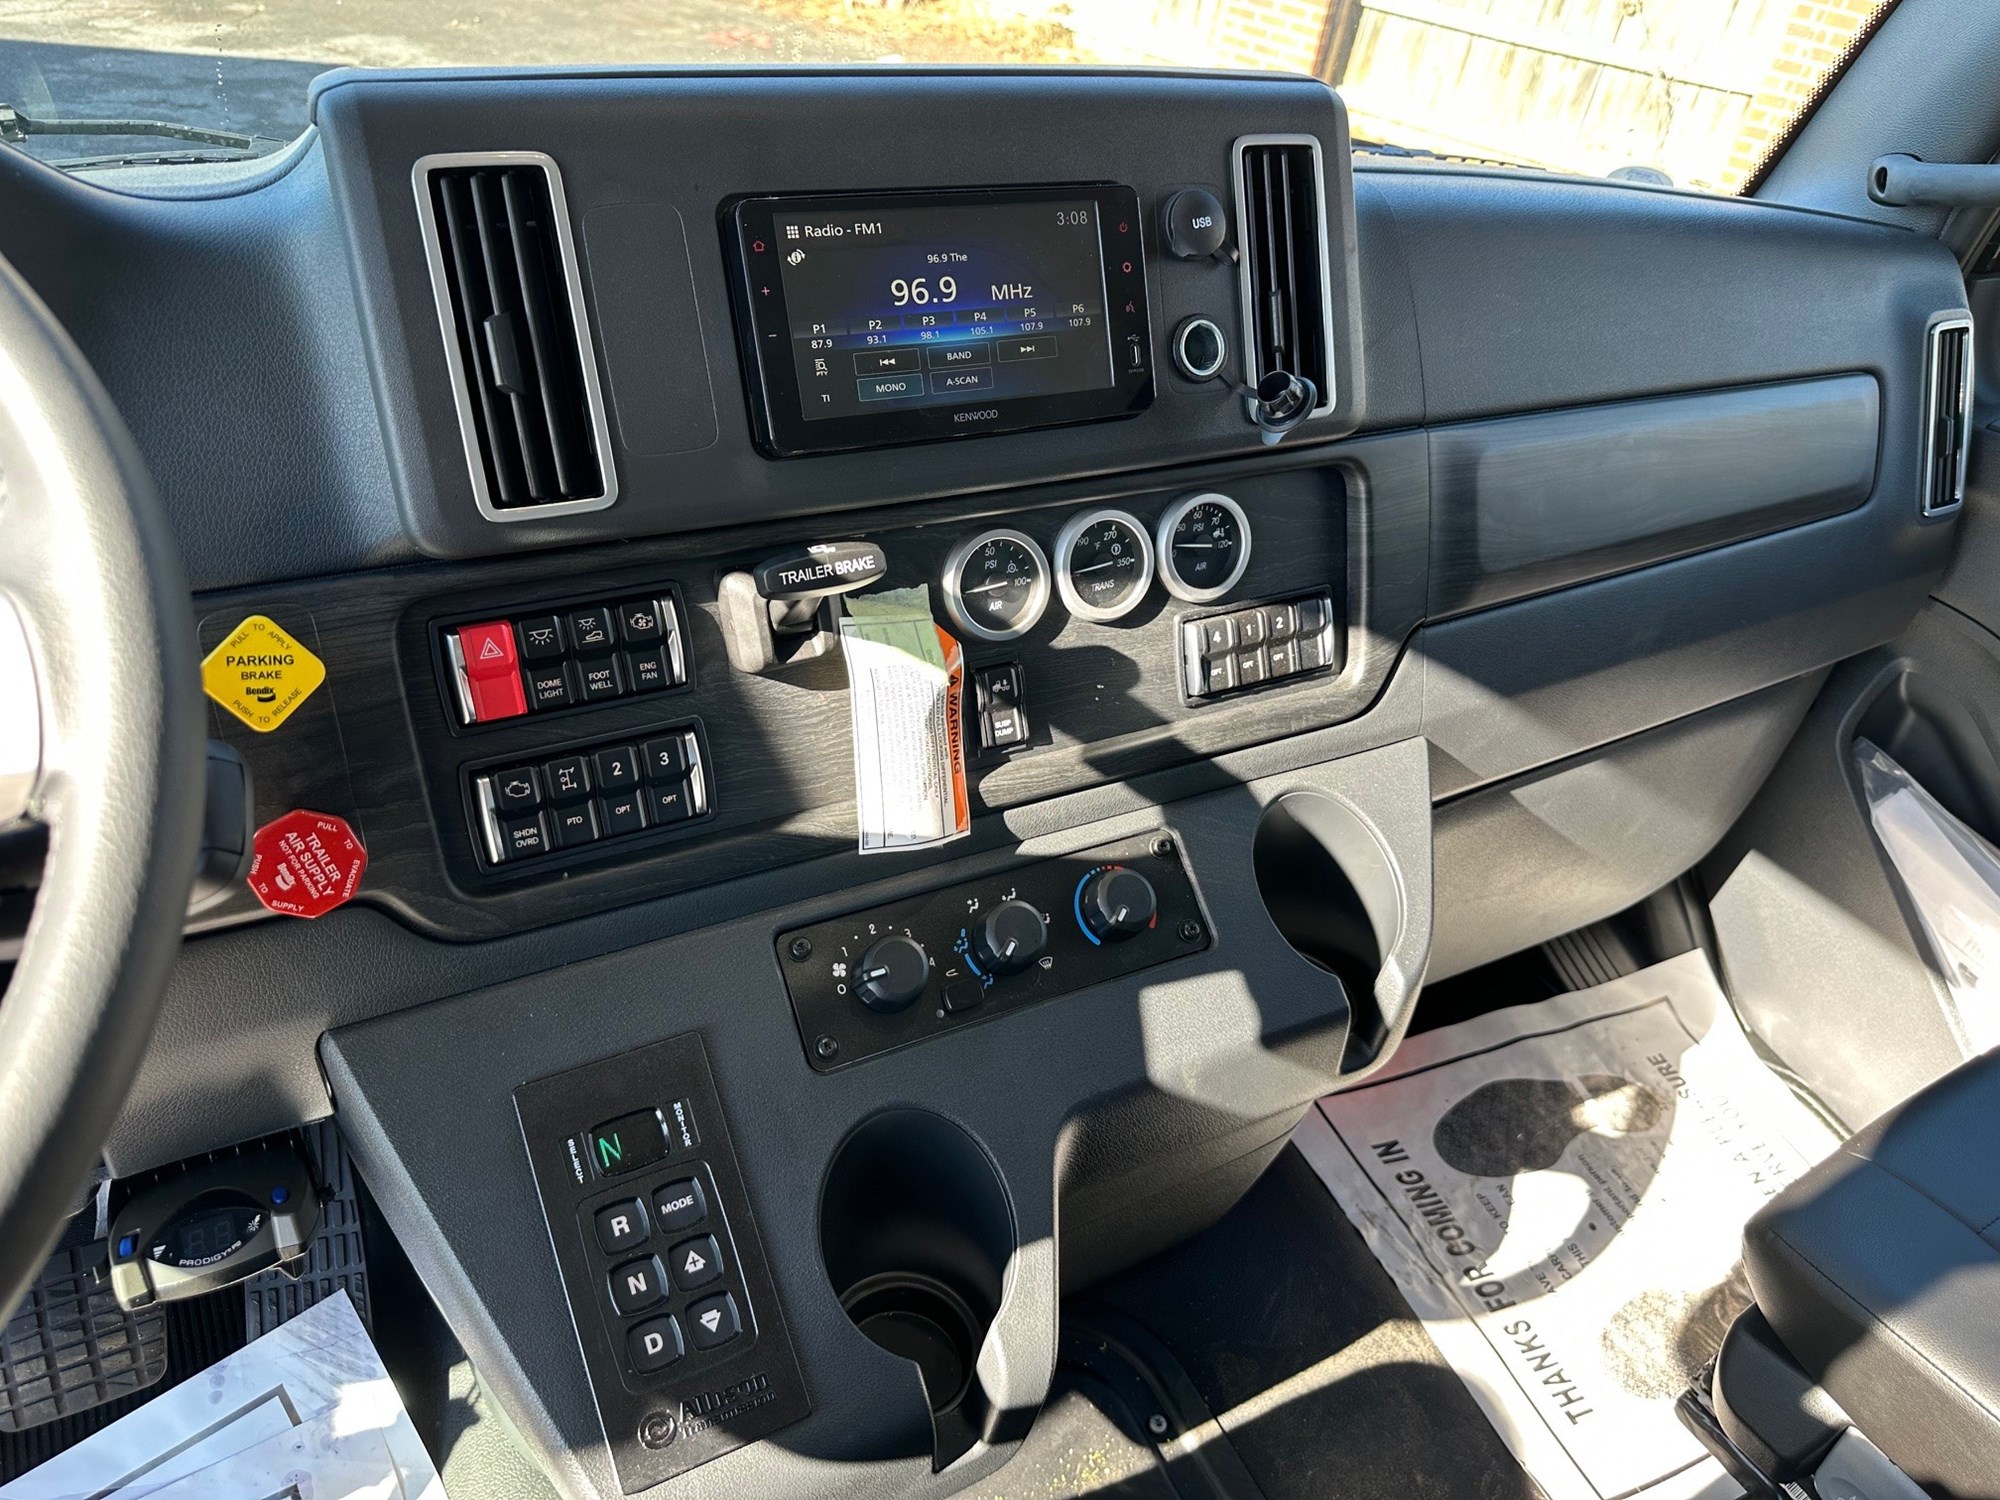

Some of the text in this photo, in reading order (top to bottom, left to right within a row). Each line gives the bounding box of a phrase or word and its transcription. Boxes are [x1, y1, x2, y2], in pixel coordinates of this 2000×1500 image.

[1056, 211, 1088, 226] 3:08
[1192, 216, 1213, 229] USB
[804, 223, 844, 238] Radio
[854, 222, 883, 235] FM1
[926, 253, 968, 264] 96.9 The
[890, 275, 1033, 307] 96.9 MHz
[812, 303, 1085, 334] P1 P2 P3 P4 P5 P6
[811, 317, 1091, 349] 87.9 93.1 98.1 105.1 107.9 107.9
[946, 350, 972, 361] BAND
[946, 375, 978, 386] A-SCAN
[875, 382, 907, 393] MONO
[954, 410, 998, 423] KENWOOD
[1193, 510, 1203, 520] 60
[1210, 516, 1220, 526] 70
[1192, 522, 1205, 533] PSI
[1103, 530, 1118, 541] 270
[1217, 539, 1229, 549] 120
[984, 547, 996, 557] 50
[984, 559, 998, 570] PSI
[1116, 556, 1131, 568] 350
[1194, 561, 1207, 572] AIR
[779, 555, 876, 586] TRAILER BRAKE
[1014, 576, 1027, 587] 100
[1091, 579, 1115, 592] TRANS
[988, 600, 1003, 612] AIR
[1275, 616, 1284, 629] 2
[1245, 623, 1252, 637] 1
[230, 623, 292, 651] PULL TO APPLY
[1213, 631, 1221, 643] 4
[226, 654, 295, 667] PARKING
[639, 661, 657, 671] ENG
[240, 670, 283, 681] BRAKE
[588, 669, 611, 680] FOOT
[641, 670, 659, 681] FAN
[536, 678, 563, 690] DOME
[589, 679, 614, 690] WELL
[245, 686, 274, 696] Bendix
[538, 687, 564, 700] LIGHT
[232, 699, 254, 718] PUSH
[271, 687, 303, 717] RELEASE
[994, 718, 1012, 729] SUSP
[949, 692, 961, 775] WARNING
[994, 727, 1014, 738] DUMP
[660, 751, 670, 766] 3
[611, 762, 623, 776] 2
[662, 794, 678, 804] OPT
[615, 804, 631, 815] OPT
[566, 816, 583, 826] PTO
[512, 827, 538, 839] SHDN
[515, 836, 539, 848] OVRD
[305, 832, 341, 882] TRAILER
[317, 821, 361, 898] PULL TO EVACUATE
[278, 839, 320, 899] NOT FOR PARKING
[284, 832, 335, 897] AIR SUPPLY
[249, 853, 304, 912] PUSH TO SUPPLY
[869, 923, 877, 935] 2
[904, 928, 912, 938] 3
[841, 946, 848, 957] 1
[929, 956, 936, 967] 4
[673, 1101, 692, 1147] MONITOR
[598, 1132, 622, 1167] N
[567, 1138, 584, 1185] SELECT
[1576, 1152, 1607, 1185] person
[660, 1194, 694, 1215] MODE
[1474, 1190, 1502, 1219] KEEP
[610, 1215, 631, 1237] R
[1566, 1241, 1590, 1267] THIS
[626, 1272, 648, 1296] N
[1369, 1136, 1594, 1426] THANKS FOR COMING IN
[644, 1331, 664, 1355] D
